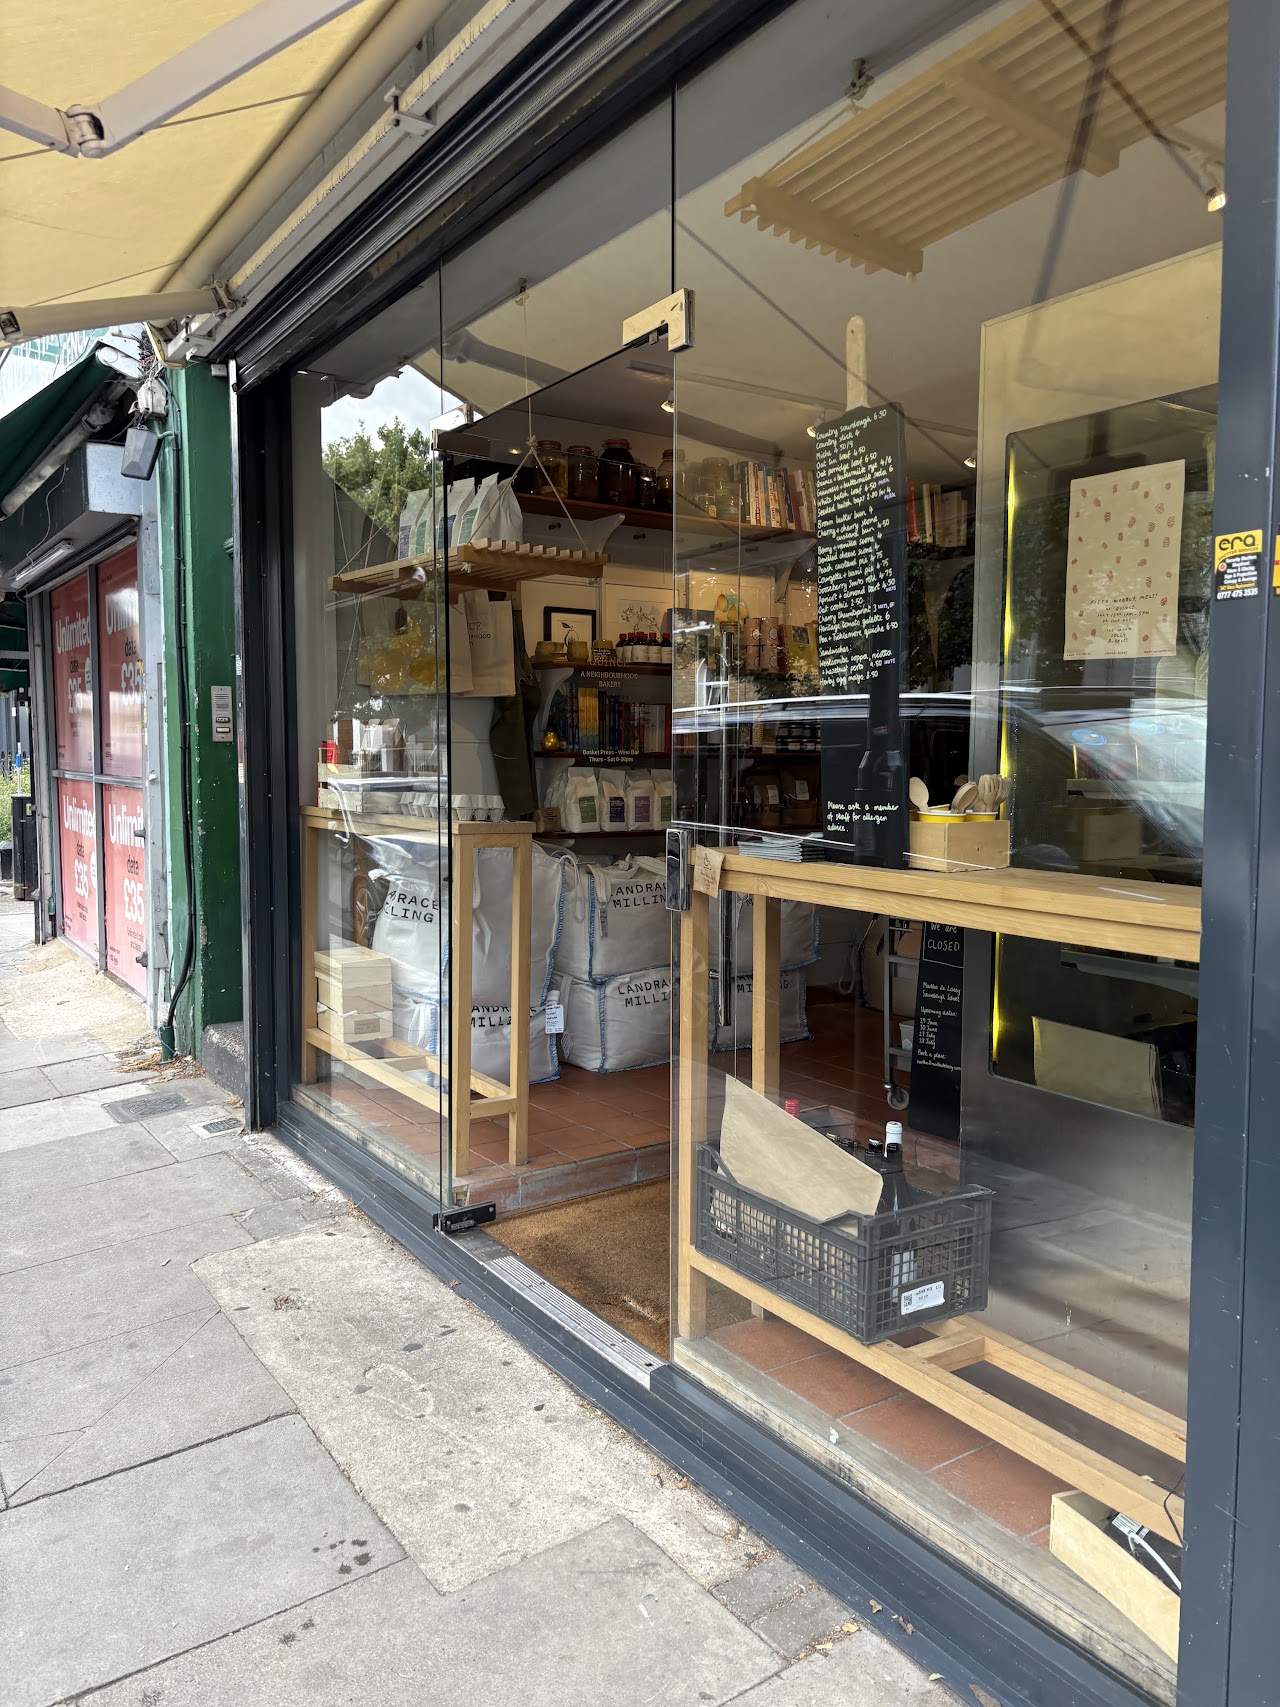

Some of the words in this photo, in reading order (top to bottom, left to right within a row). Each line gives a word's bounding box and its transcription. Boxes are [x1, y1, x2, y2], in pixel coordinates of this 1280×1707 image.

[816, 429, 838, 441] Country
[840, 416, 872, 432] sourdough
[816, 439, 838, 450] Country
[816, 460, 827, 470] Oat
[839, 450, 851, 461] loaf
[816, 470, 827, 479] Oat
[828, 463, 850, 476] porridge
[851, 456, 863, 468] loaf
[837, 467, 866, 481] buttermilk
[868, 462, 878, 473] rye
[889, 464, 893, 472] 6
[851, 485, 862, 495] loaf
[818, 519, 834, 529] Brown
[836, 513, 853, 523] butter
[854, 510, 866, 519] bun
[836, 531, 859, 541] custard
[862, 526, 875, 535] bun
[841, 523, 859, 534] cherry
[859, 535, 875, 545] scone
[1218, 534, 1256, 551] era
[839, 550, 856, 559] cheese
[835, 558, 857, 570] custard
[843, 586, 866, 598] almond
[868, 582, 880, 593] tart
[1217, 591, 1231, 600] 0777
[818, 605, 829, 614] Oat
[830, 601, 848, 611] cookie
[838, 605, 871, 619] thumbprint
[841, 619, 860, 628] tomato
[862, 614, 883, 628] galette
[885, 611, 890, 620] 6
[864, 624, 885, 638] quiche
[125, 636, 136, 657] data
[586, 671, 639, 679] NEIGHBOURHOOD
[836, 676, 847, 686] egg
[598, 680, 621, 688] BAKERY
[827, 801, 845, 810] Please
[847, 802, 861, 811] ask
[873, 802, 899, 811] member
[827, 812, 833, 822] of
[835, 812, 850, 822] staff
[852, 812, 860, 822] for
[862, 812, 887, 825] allergen
[108, 804, 144, 849] Unlimit
[126, 854, 139, 876] data
[74, 858, 89, 900] £35
[610, 882, 666, 896] ANDRA
[123, 877, 144, 926] £35
[612, 894, 666, 908] MILLIN
[930, 922, 941, 932] We
[945, 923, 958, 934] are
[927, 938, 961, 952] CLOSED
[617, 979, 672, 995] LANDRA
[625, 990, 670, 1007] MILLI
